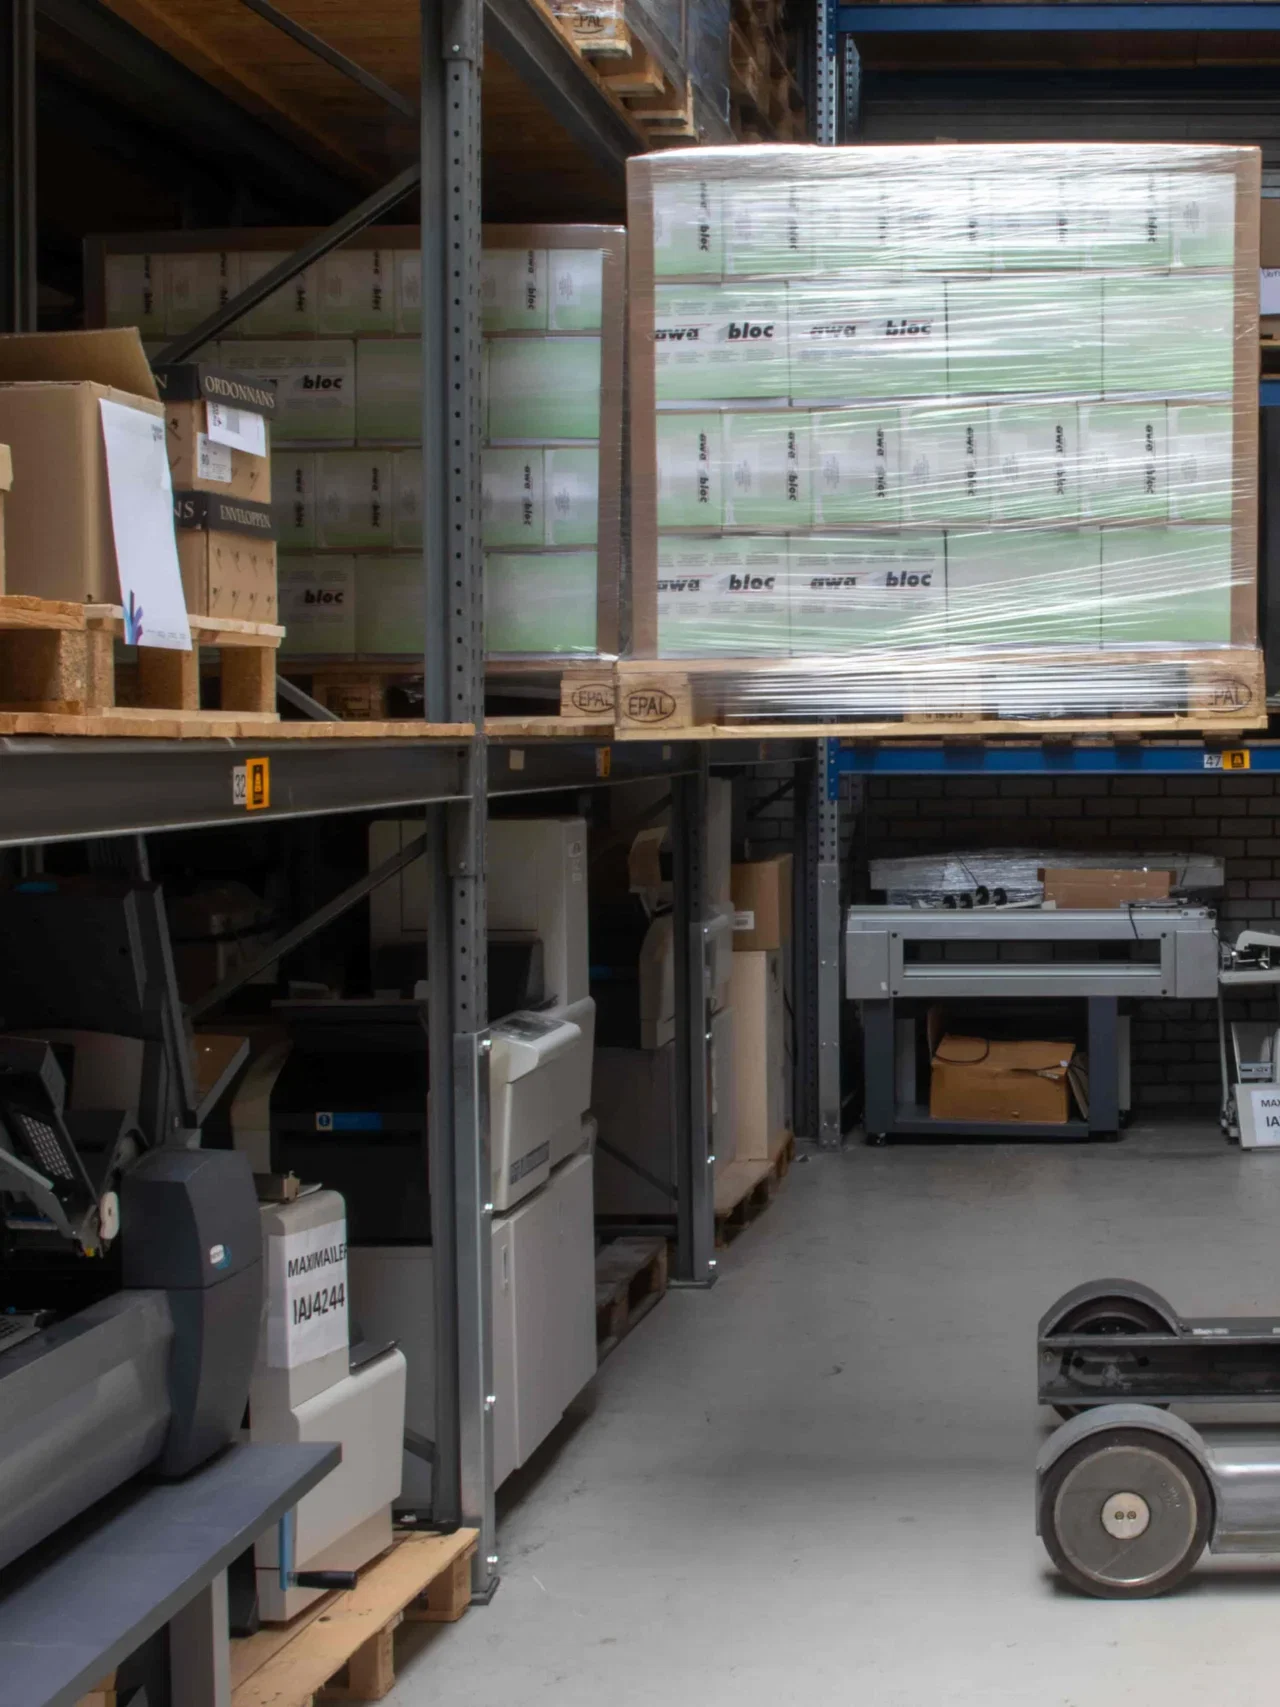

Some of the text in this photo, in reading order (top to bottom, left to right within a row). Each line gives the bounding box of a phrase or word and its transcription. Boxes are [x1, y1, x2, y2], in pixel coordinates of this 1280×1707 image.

[700, 224, 710, 251] bloc
[526, 288, 537, 311] bloc
[728, 322, 774, 340] bloc
[886, 319, 932, 336] bloc
[205, 375, 276, 409] ORDONNANS
[303, 374, 343, 390] bloc
[700, 476, 709, 503] bloc
[788, 474, 798, 501] bloc
[219, 503, 272, 530] ENVELOPPEN
[523, 500, 533, 526] bloc
[656, 573, 776, 592] awa bloc
[886, 570, 932, 588] bloc
[304, 589, 344, 605] bloc
[579, 690, 613, 707] EPAL
[628, 696, 668, 716] EPAL
[1205, 755, 1222, 767] 47
[235, 773, 247, 798] 32
[293, 1282, 346, 1325] IAJ4244
